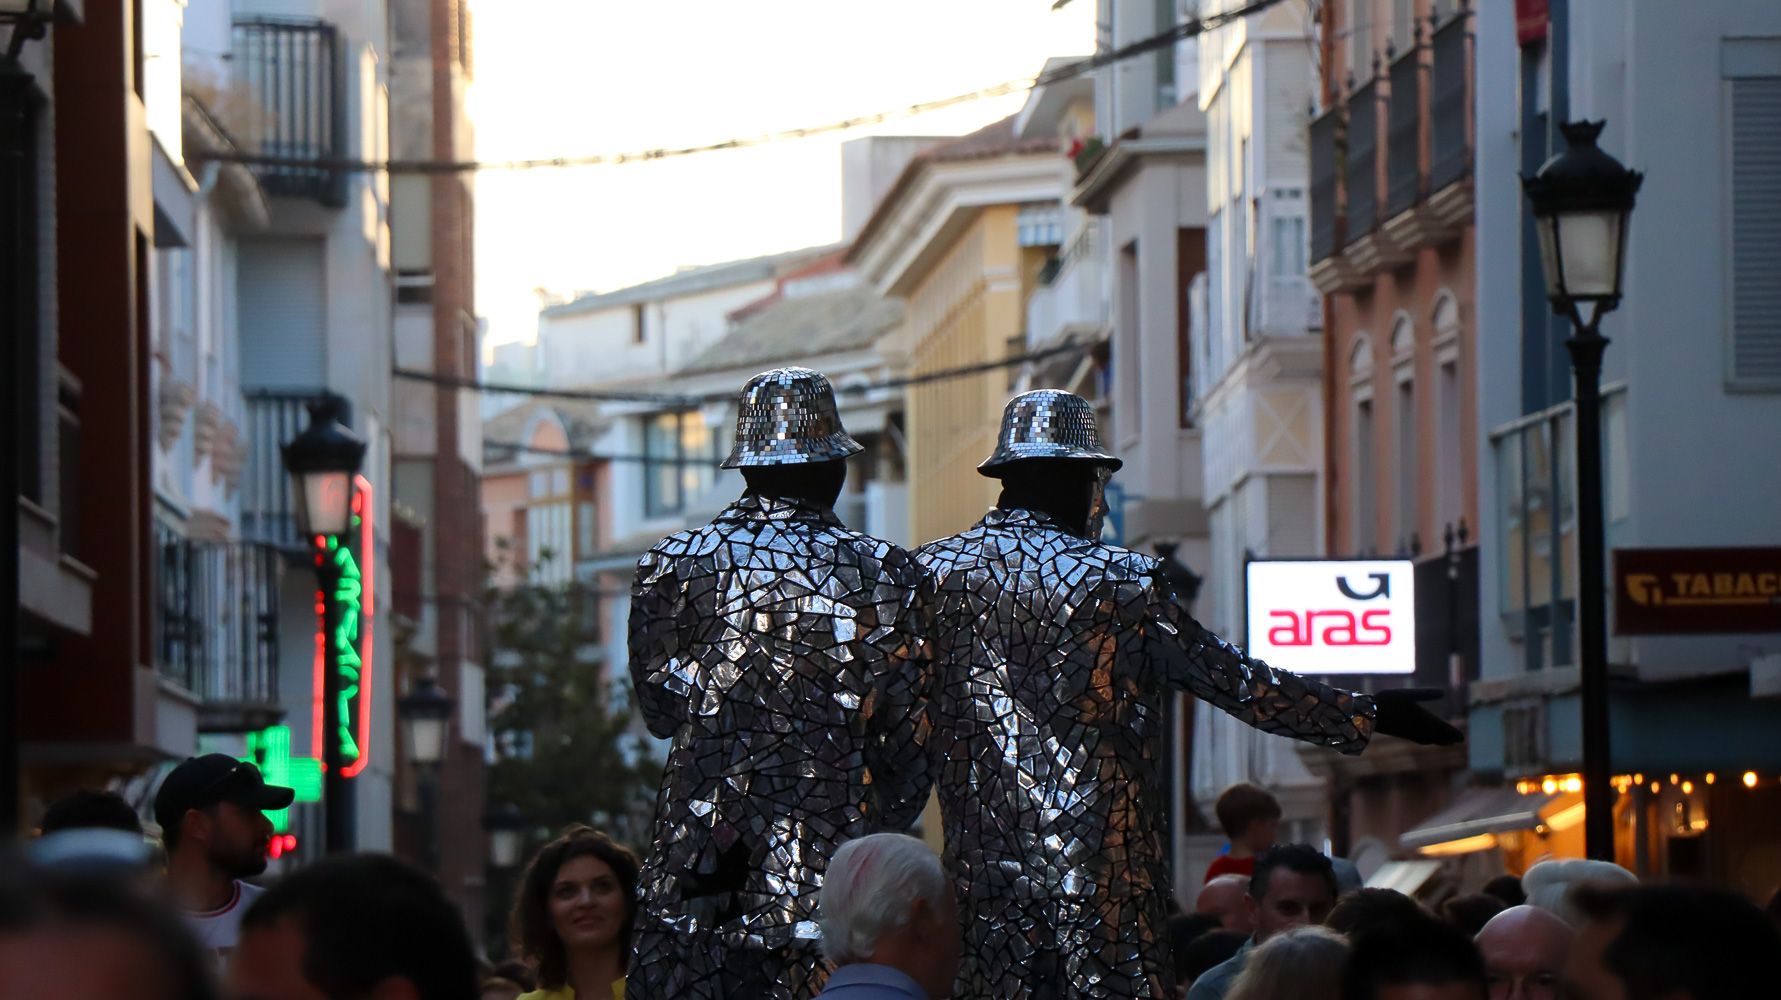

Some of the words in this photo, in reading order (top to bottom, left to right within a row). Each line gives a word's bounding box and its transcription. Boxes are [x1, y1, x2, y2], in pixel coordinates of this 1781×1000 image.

[1672, 573, 1781, 595] TABAC
[328, 515, 361, 758] ARMACIA
[1268, 609, 1391, 646] aras
